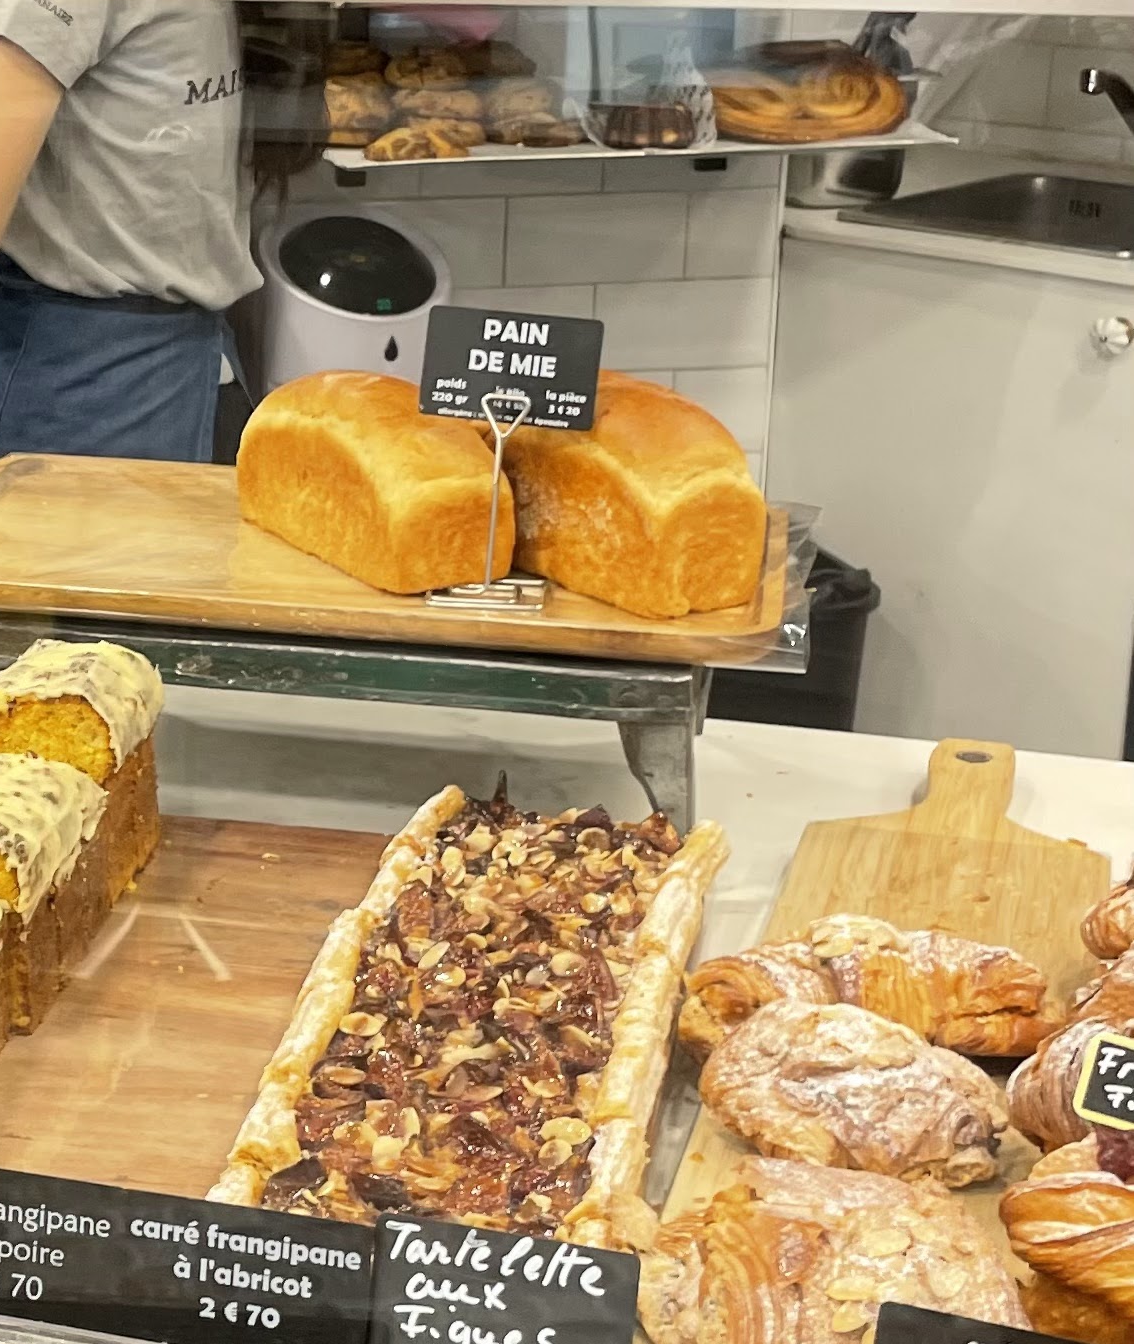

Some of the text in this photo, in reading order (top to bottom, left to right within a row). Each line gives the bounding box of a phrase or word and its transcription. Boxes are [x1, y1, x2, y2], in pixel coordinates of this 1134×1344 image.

[483, 318, 549, 346] PAIN
[468, 348, 557, 378] DE MIE
[431, 391, 453, 402] 220
[436, 377, 467, 390] poids
[130, 1218, 362, 1271] carré frangipane
[11, 1273, 43, 1301] 70
[173, 1254, 312, 1299] à l'abricot
[405, 1272, 507, 1310] aux
[199, 1297, 281, 1329] 2 € 70
